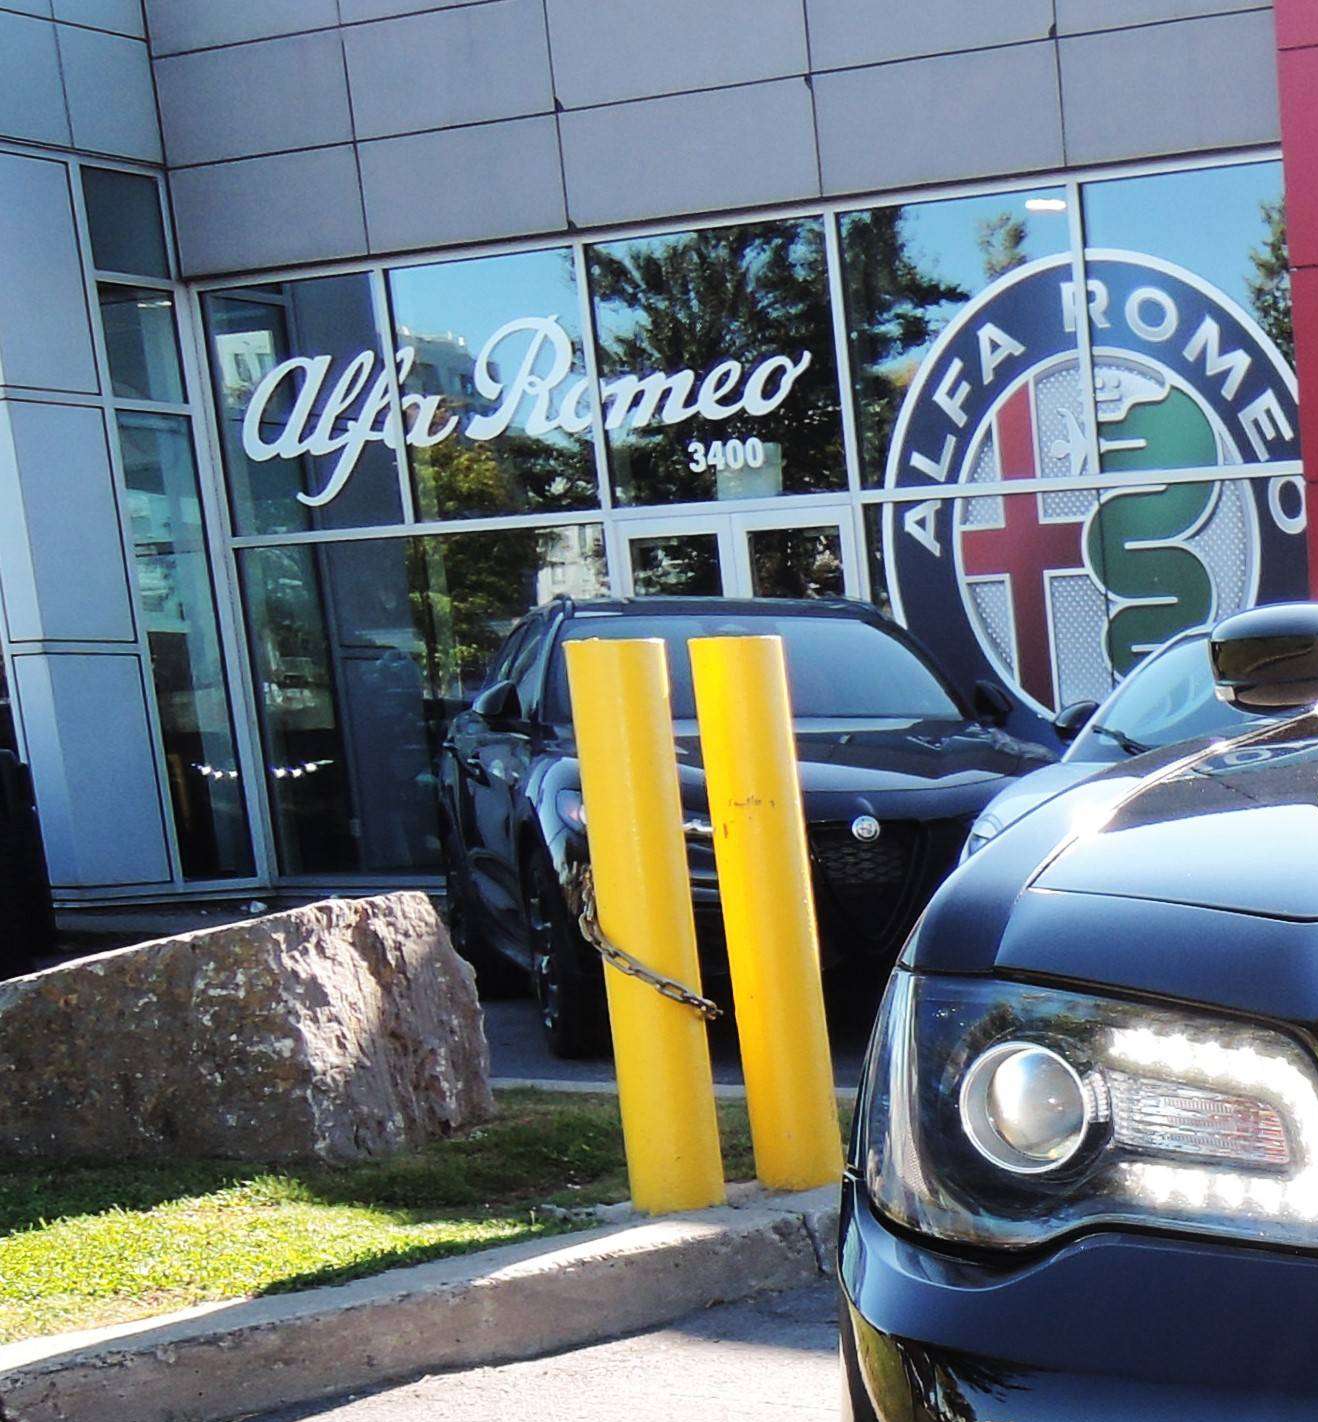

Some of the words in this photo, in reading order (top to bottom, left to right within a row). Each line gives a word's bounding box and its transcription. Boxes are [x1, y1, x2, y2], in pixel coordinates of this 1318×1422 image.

[242, 345, 459, 507] Alfa
[466, 314, 812, 441] Romeo
[687, 436, 764, 473] 3400
[904, 321, 1027, 557] ALFA
[1060, 279, 1307, 535] ROMEO
